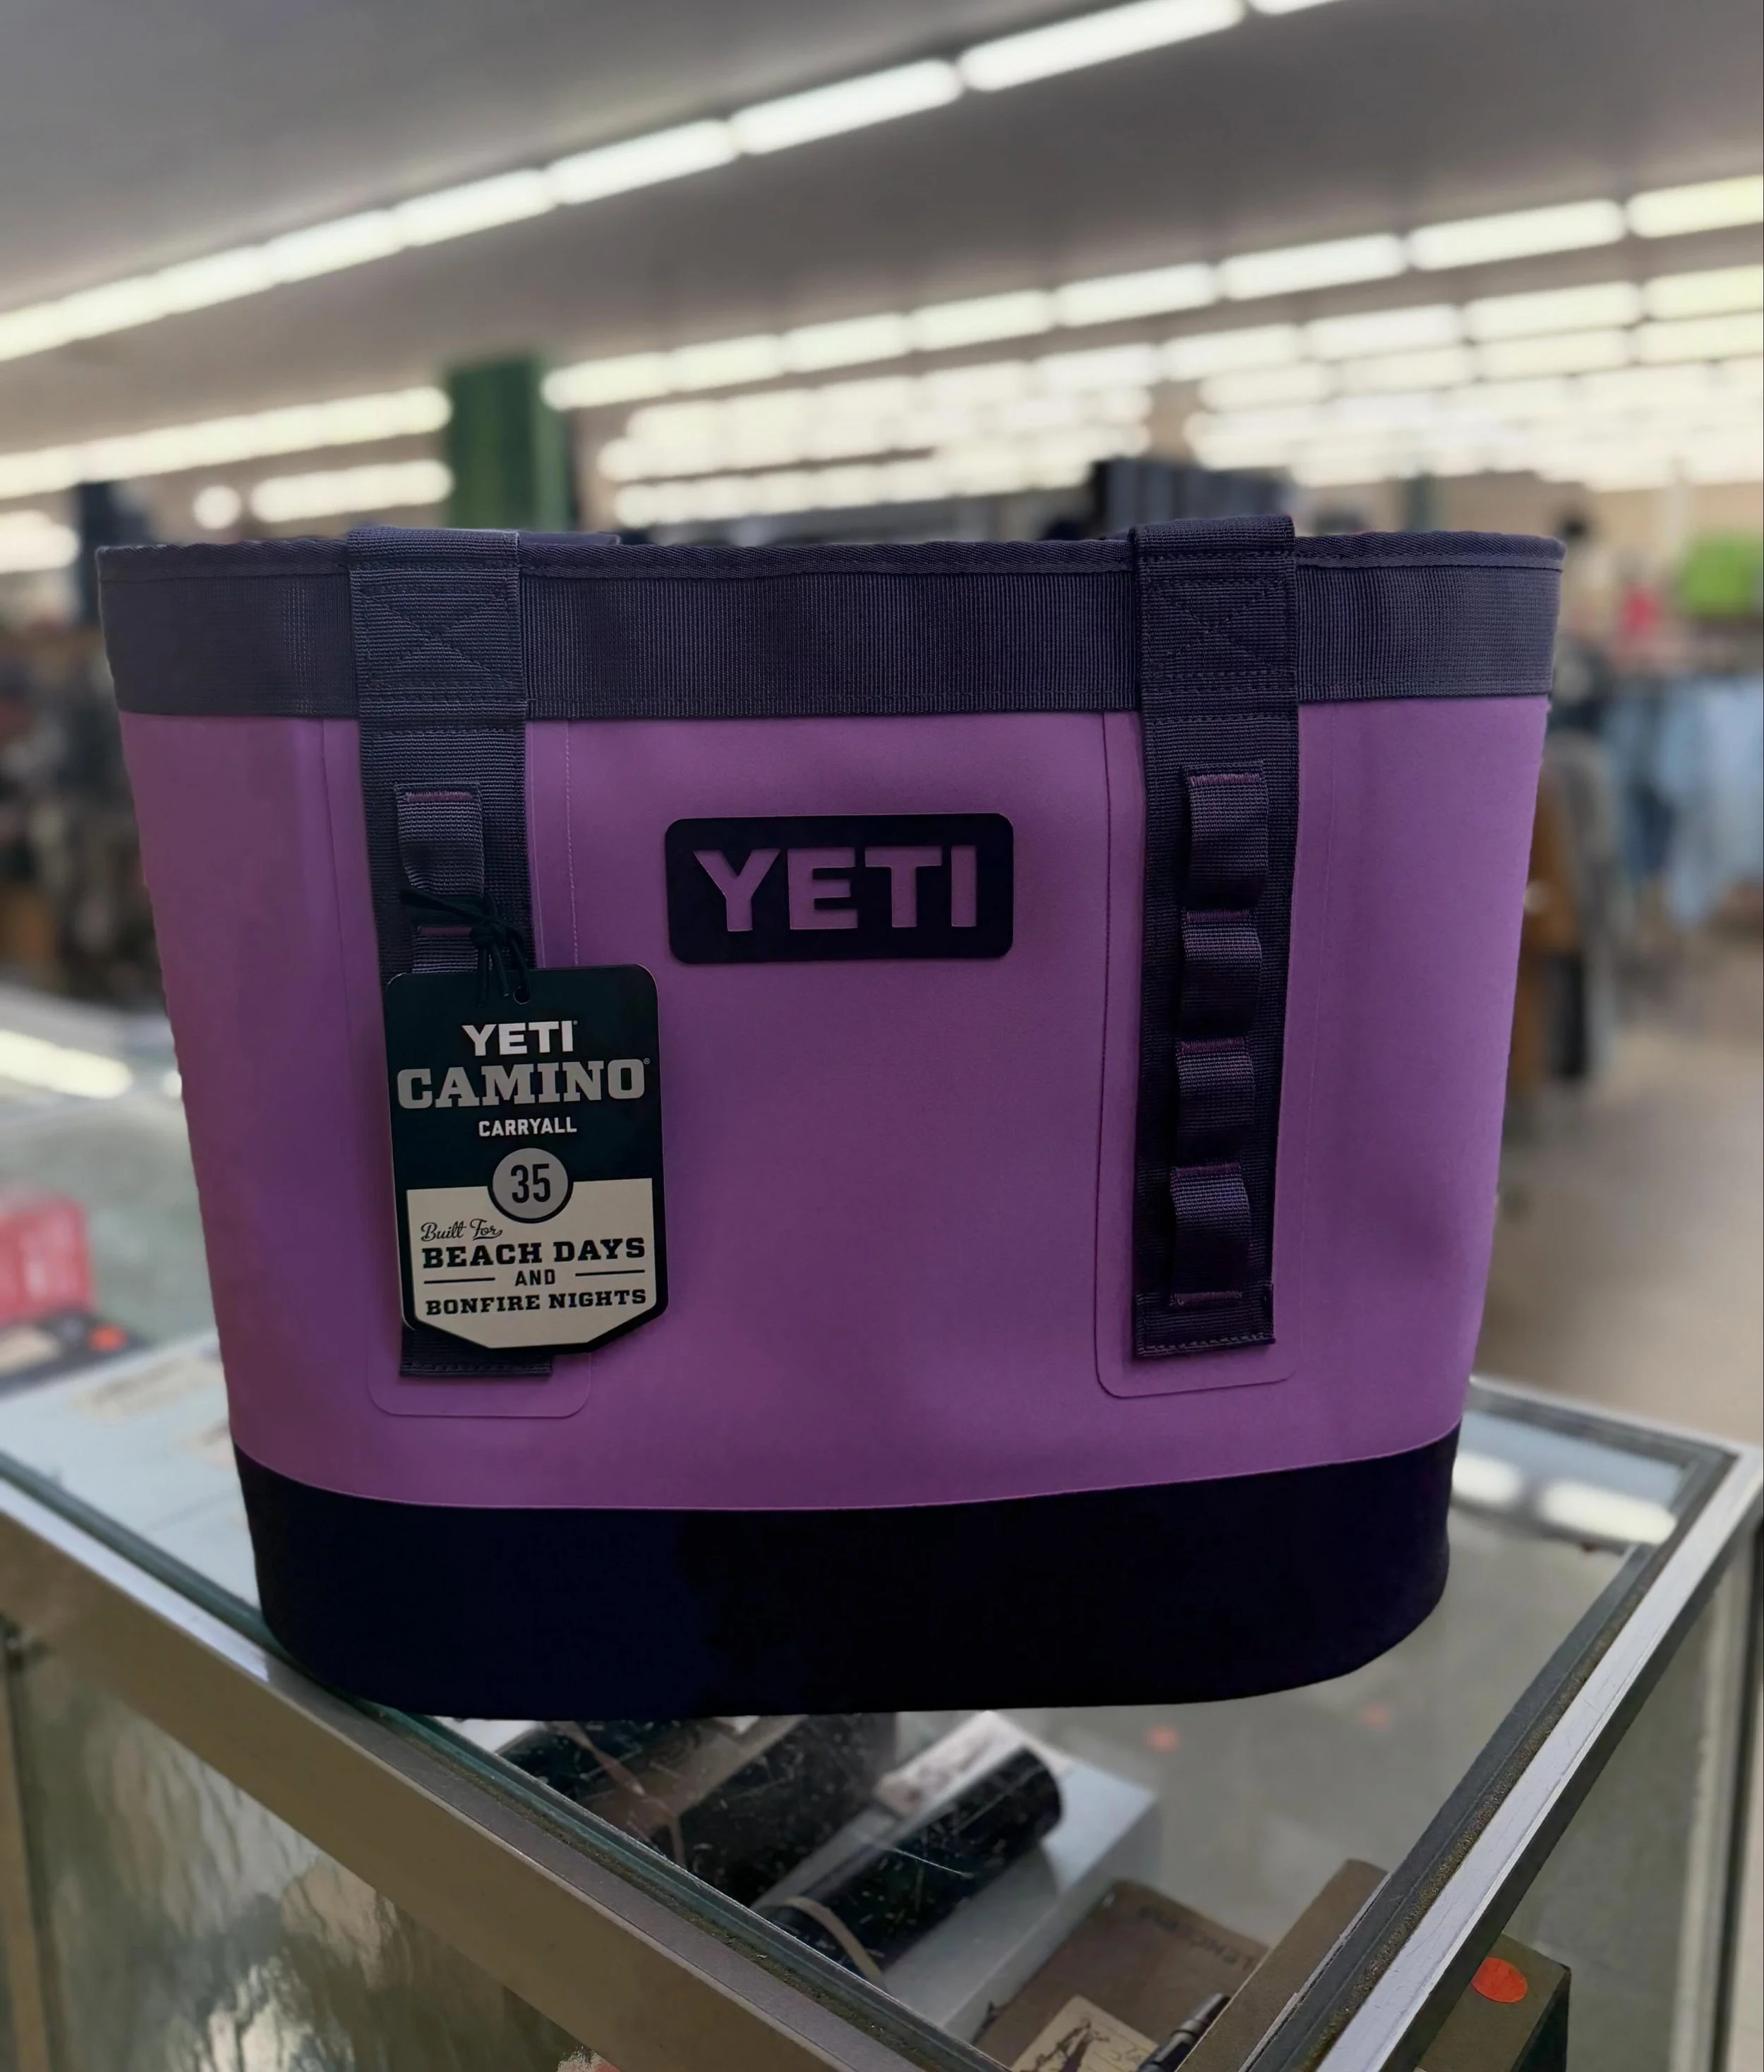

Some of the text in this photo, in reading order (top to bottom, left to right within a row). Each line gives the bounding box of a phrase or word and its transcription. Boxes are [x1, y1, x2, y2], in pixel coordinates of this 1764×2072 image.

[693, 846, 977, 932] YETI
[478, 1117, 578, 1137] CARRYALL
[510, 1164, 551, 1203] 35
[421, 1219, 502, 1241] Built For
[422, 1237, 645, 1269] BEACH DAYS
[514, 1270, 555, 1286] AND
[425, 1289, 646, 1315] BONFIRE NIGHTS
